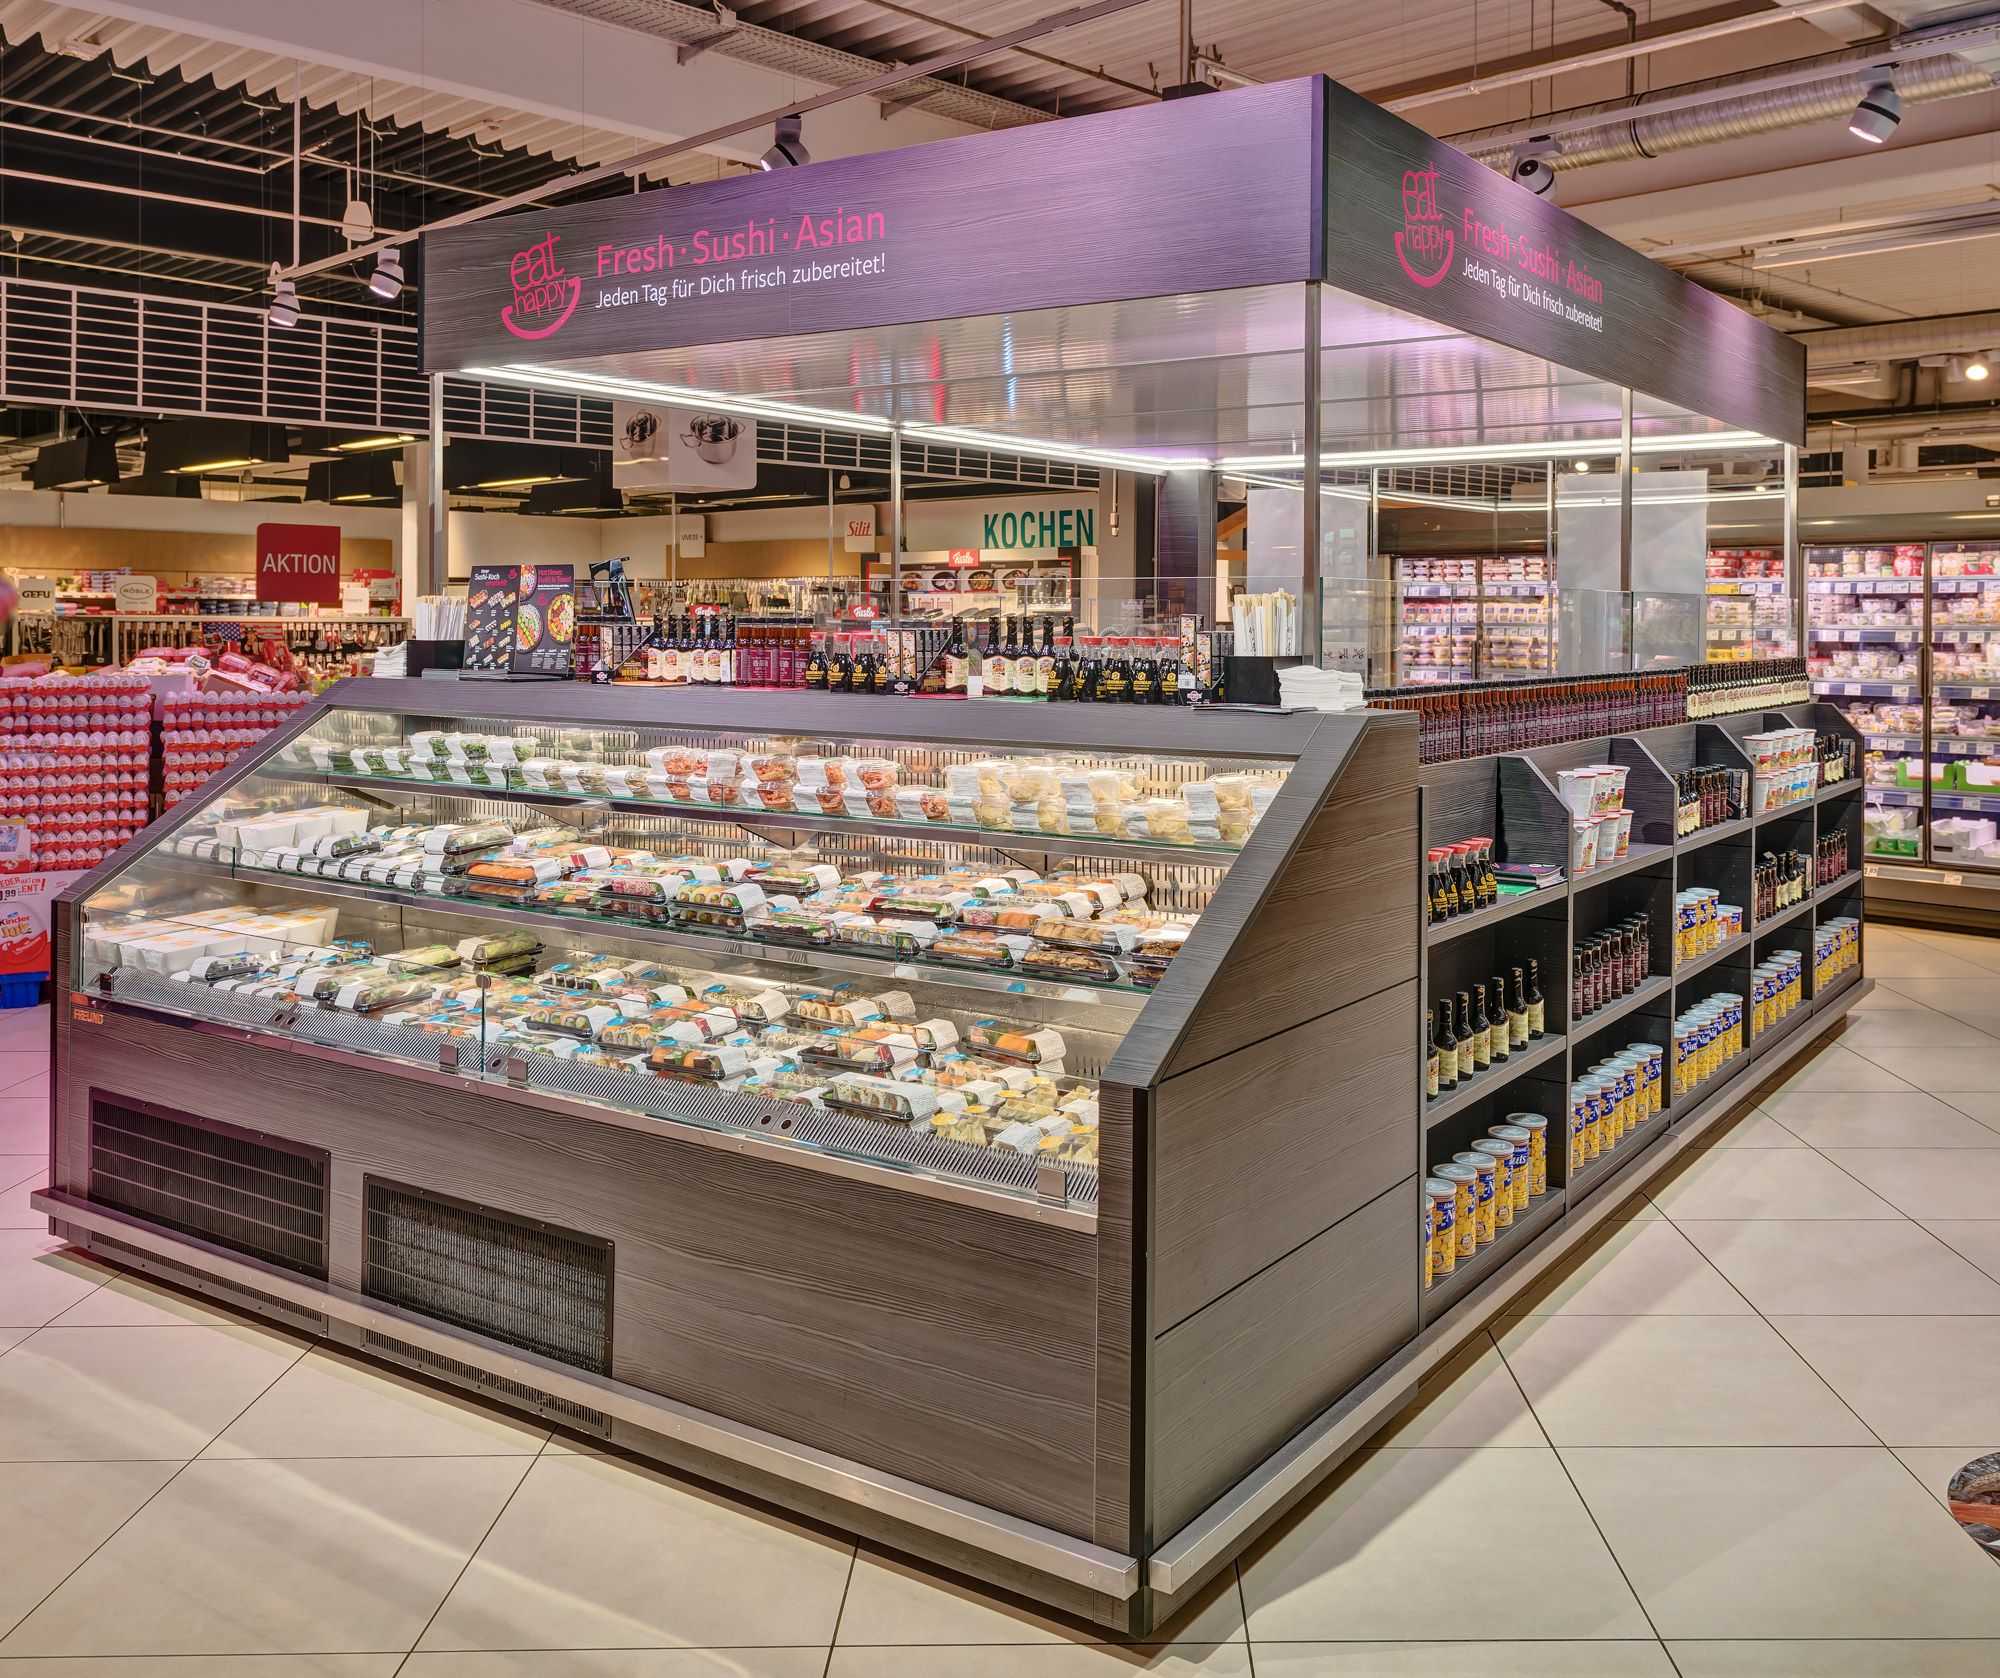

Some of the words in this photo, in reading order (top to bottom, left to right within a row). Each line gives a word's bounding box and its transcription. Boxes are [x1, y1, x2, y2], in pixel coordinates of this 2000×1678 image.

[1402, 161, 1443, 221] eat
[597, 233, 674, 279] Fresh
[693, 217, 776, 265] Sushi
[795, 207, 886, 251] Asian
[1404, 216, 1445, 261] happy
[1464, 207, 1510, 262] Fresh
[1518, 235, 1559, 284] Sushi
[1567, 260, 1604, 304] Asian
[510, 231, 564, 290] eat
[595, 287, 639, 309] Jeden
[641, 284, 668, 307] Tag
[672, 278, 695, 299] für
[700, 273, 736, 296] Dich
[740, 265, 786, 290] frisch
[792, 252, 886, 284] zubereitet!
[512, 275, 568, 317] happy
[1462, 257, 1490, 286] Jeden
[1490, 269, 1507, 299] Tag
[1508, 273, 1521, 298] für
[1522, 283, 1541, 307] Dich
[1542, 292, 1564, 317] frisch
[1565, 304, 1603, 333] zubereitet!
[848, 521, 872, 537] Silit
[984, 508, 1094, 548] KOCHEN
[262, 552, 336, 575] AKTION
[952, 550, 975, 565] Fissler
[22, 590, 51, 599] GEFU
[123, 587, 150, 595] RÖSLE
[853, 605, 876, 618] Fissler
[0, 876, 20, 888] EDER
